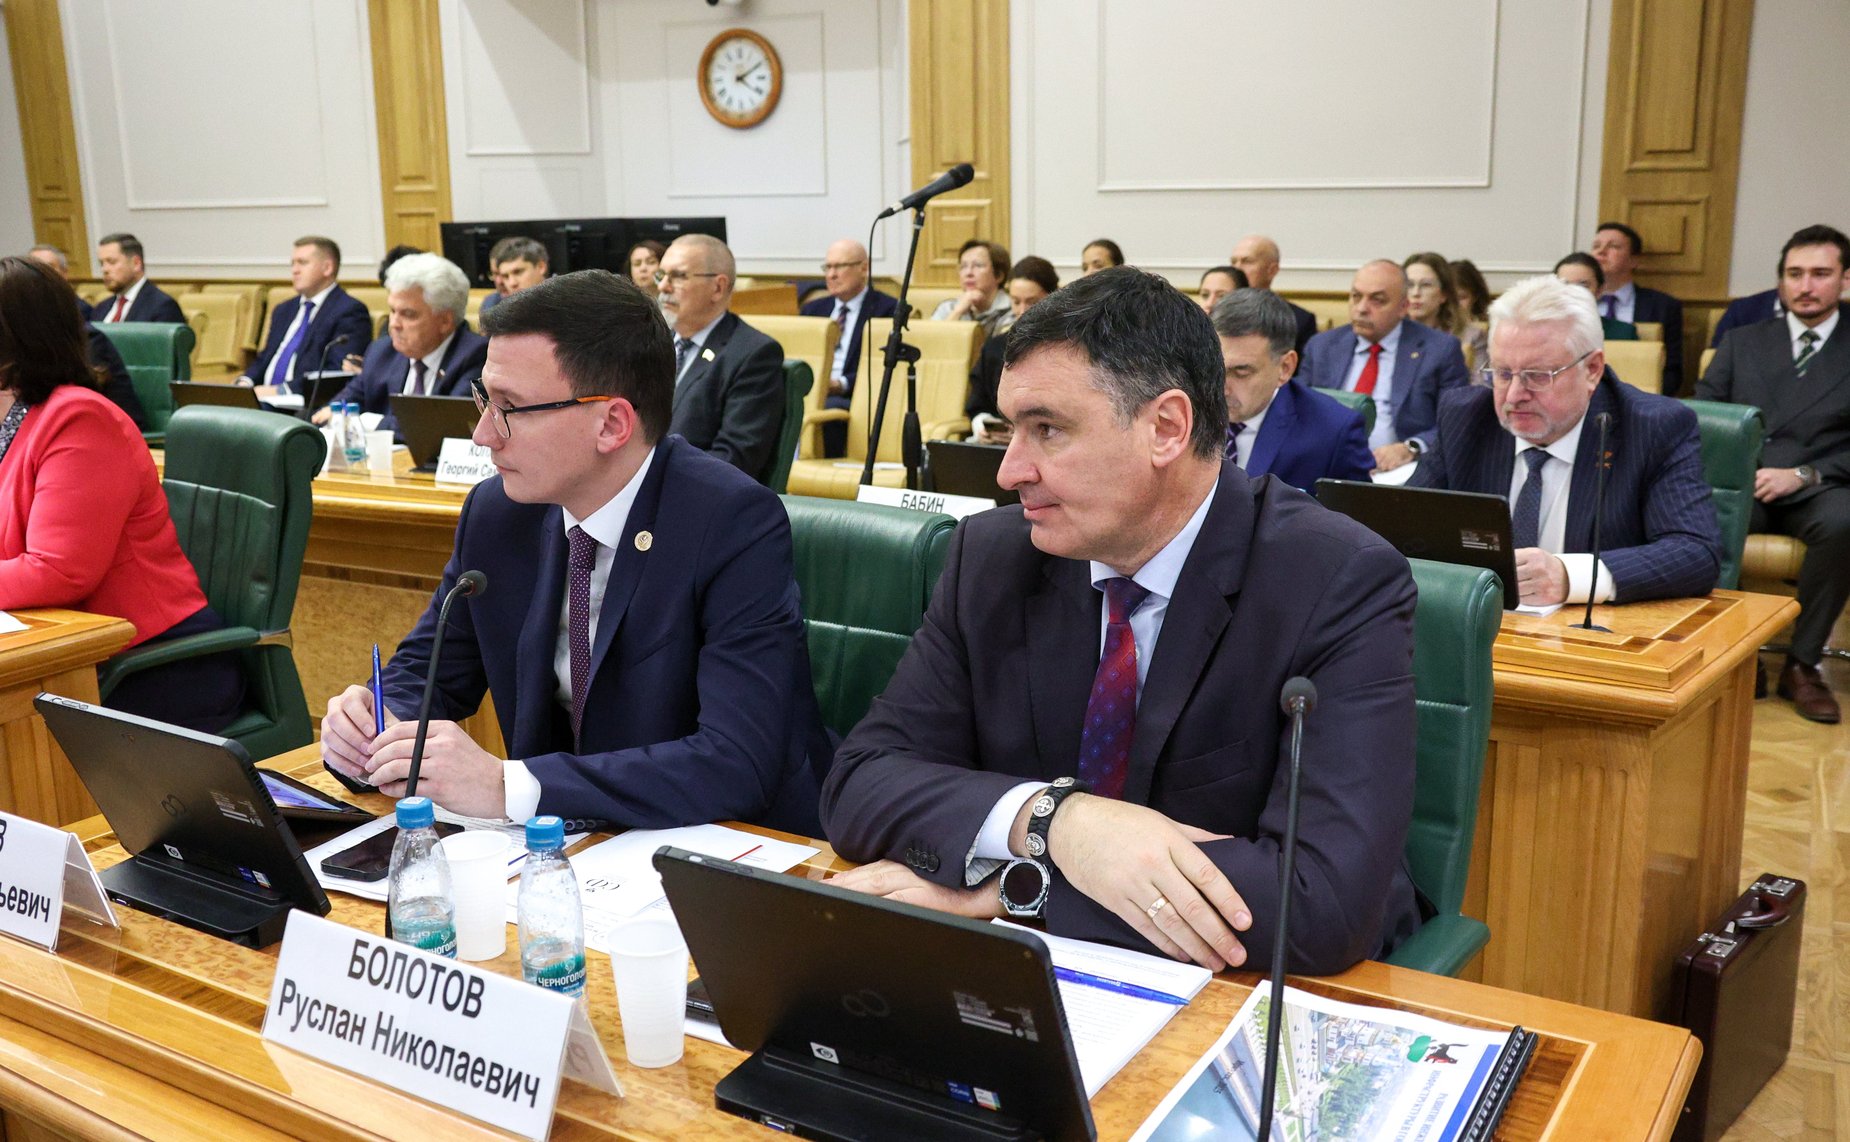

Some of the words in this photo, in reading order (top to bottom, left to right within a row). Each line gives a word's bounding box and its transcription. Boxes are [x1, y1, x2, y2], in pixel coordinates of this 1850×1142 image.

[441, 461, 479, 478] Георгий
[901, 493, 945, 513] БАБИН
[347, 939, 485, 1018] БОЛОТОВ
[278, 978, 367, 1045] Руслан
[371, 1011, 540, 1108] Николаевич
